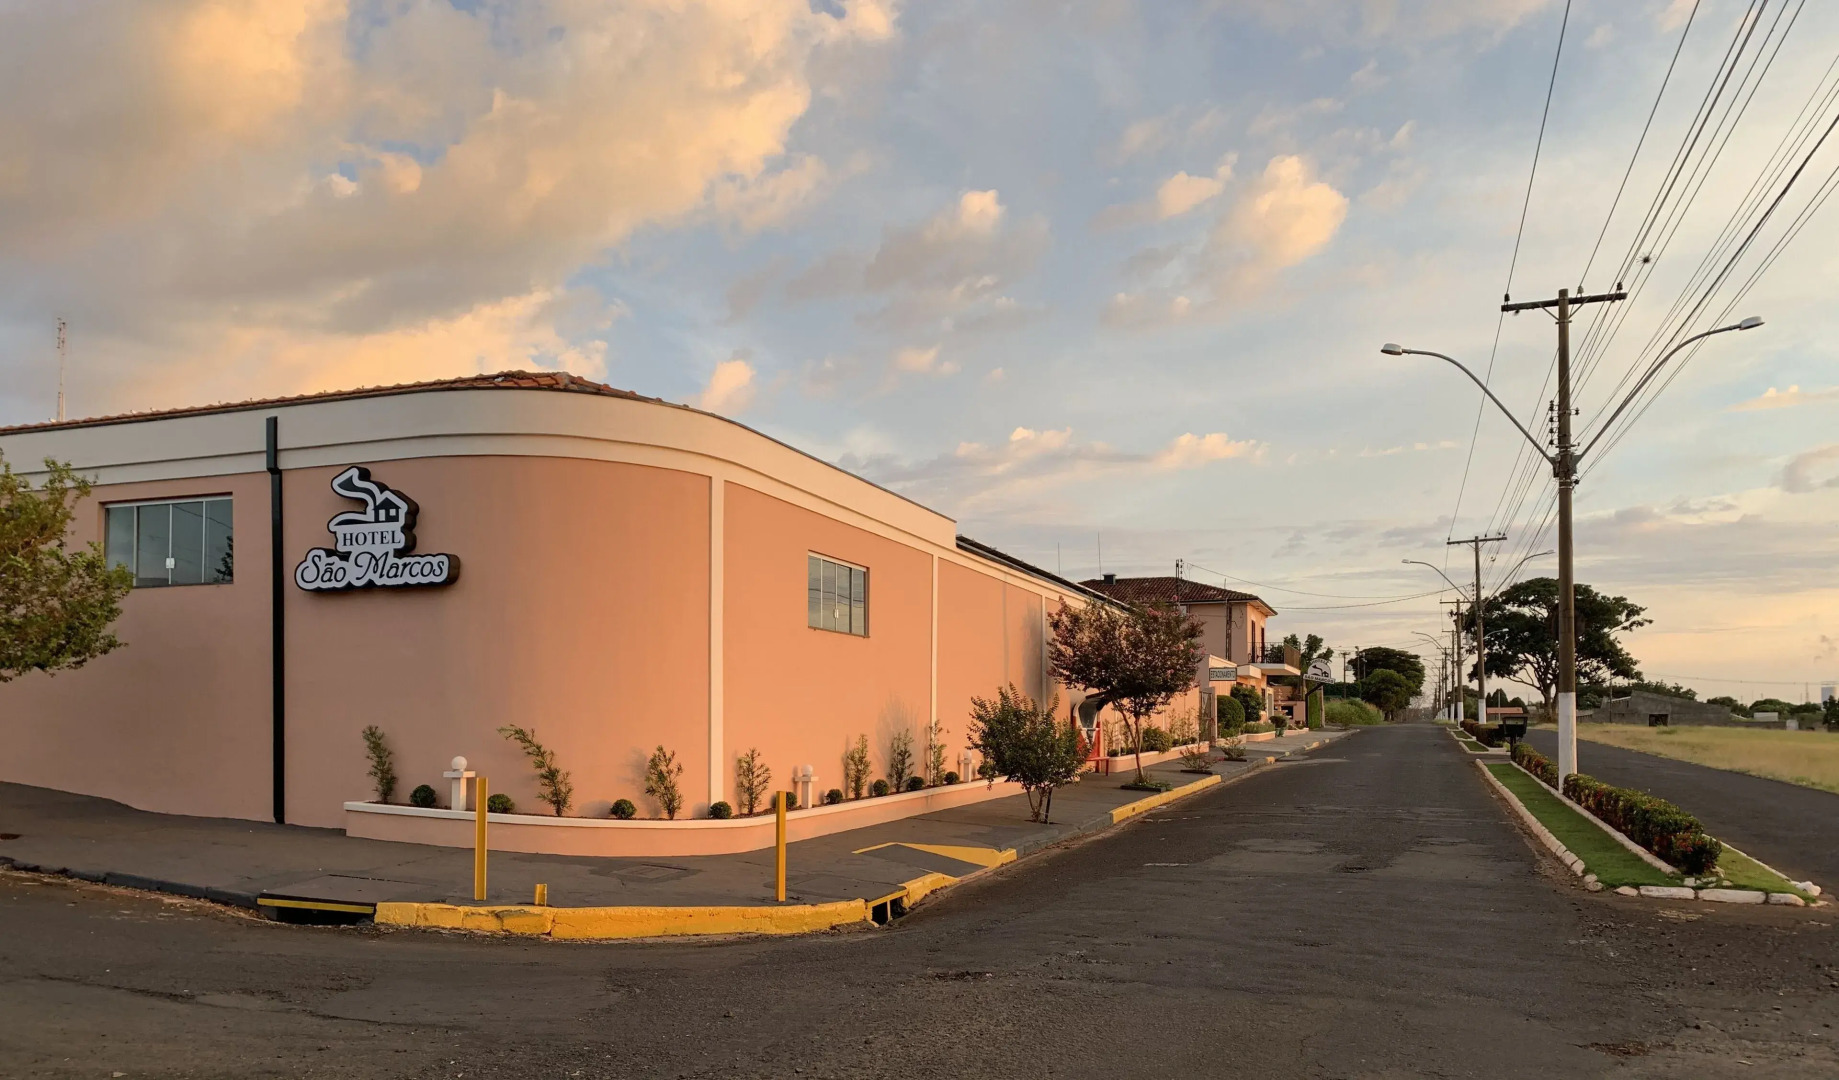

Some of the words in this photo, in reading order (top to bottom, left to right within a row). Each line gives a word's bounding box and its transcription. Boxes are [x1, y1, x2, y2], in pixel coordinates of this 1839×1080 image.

[342, 530, 401, 546] HOTEL
[300, 554, 347, 584] São
[354, 551, 445, 580] Marcos
